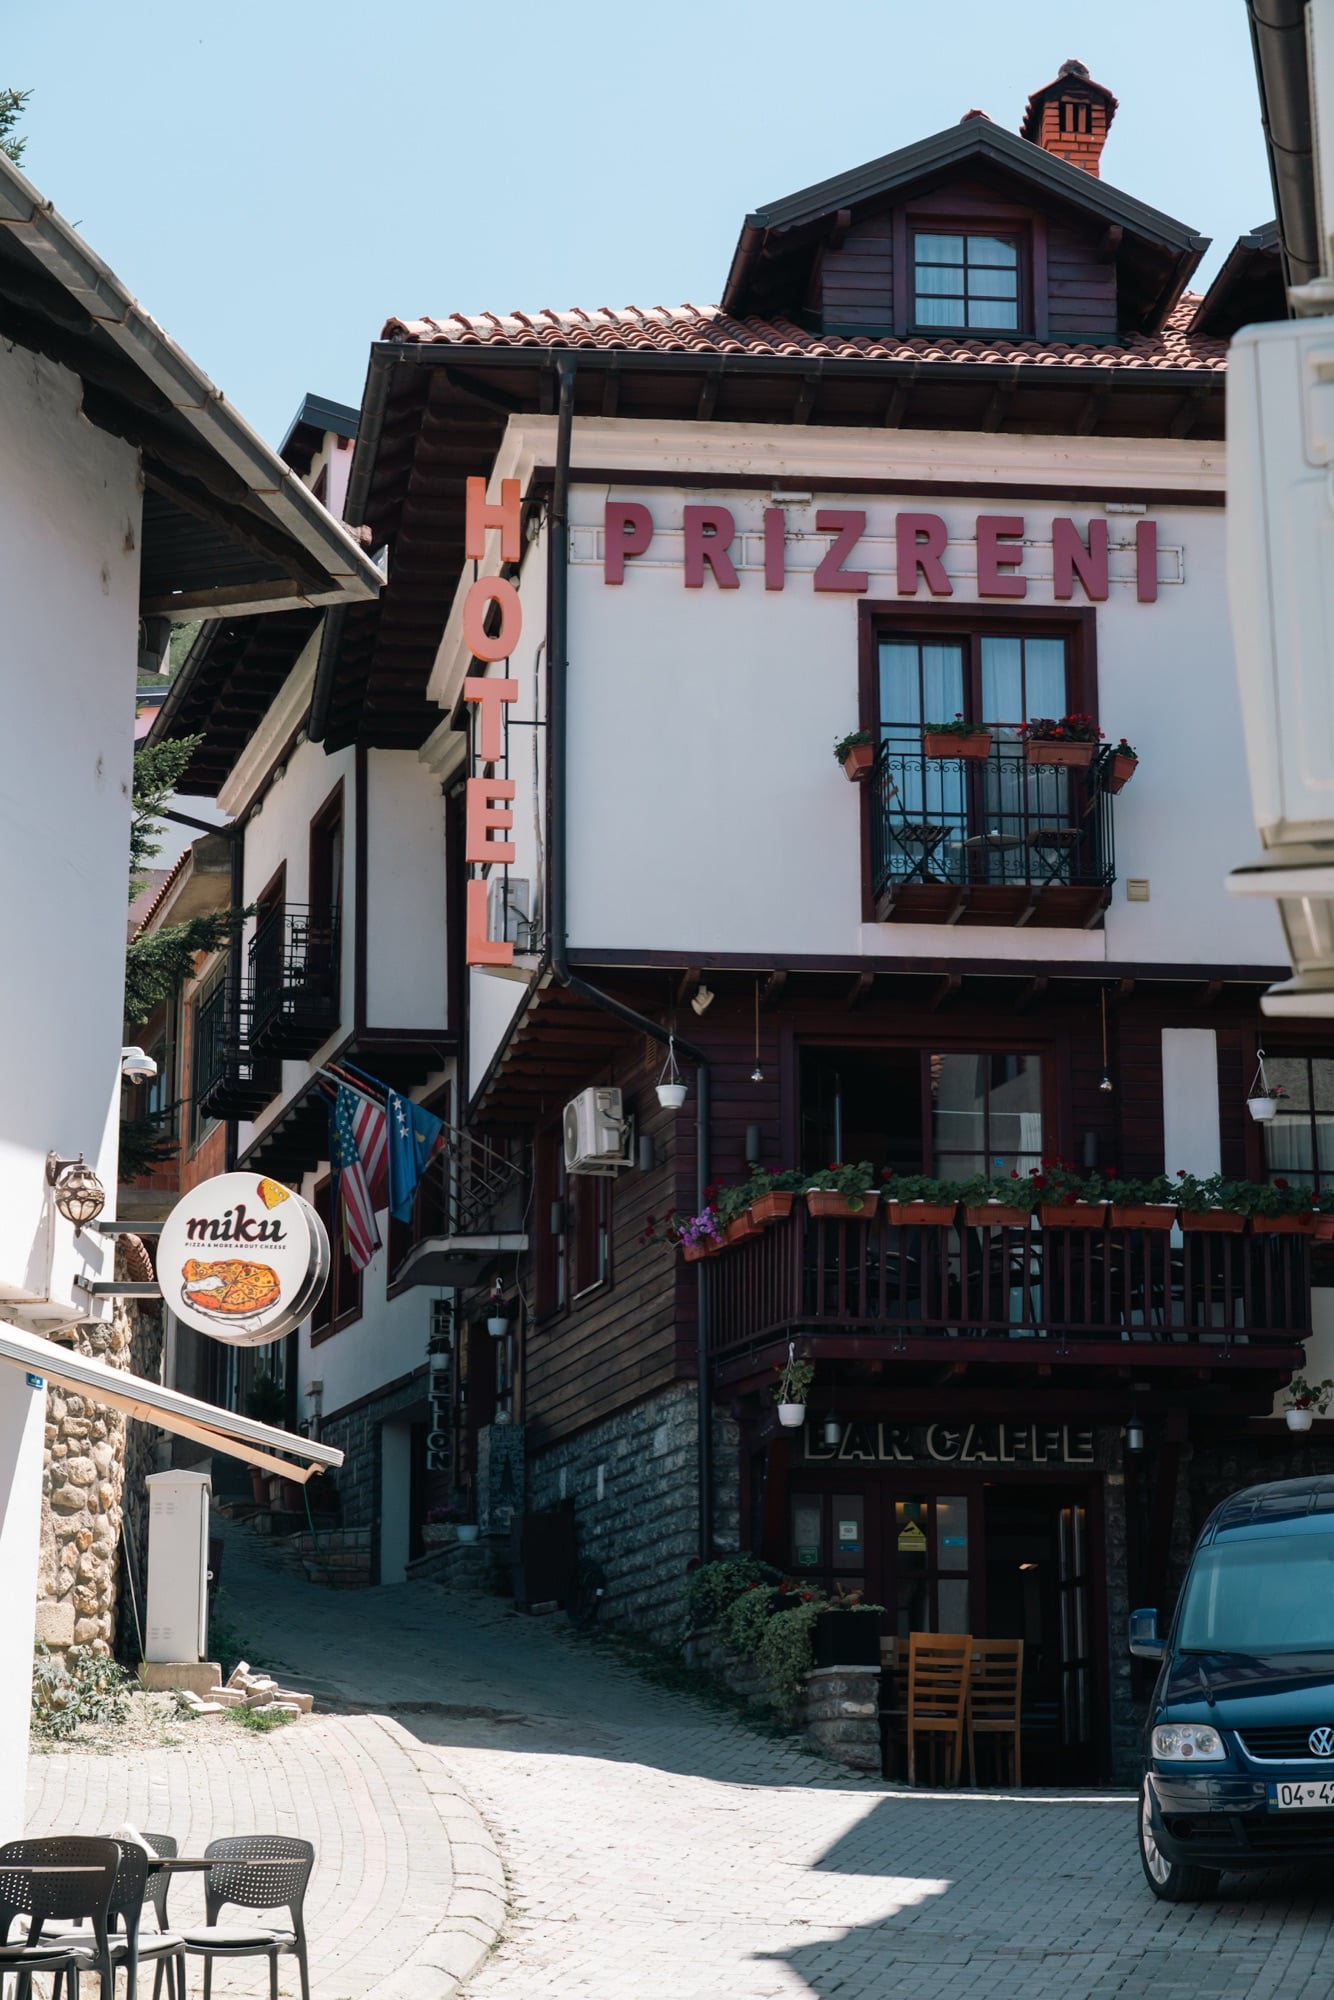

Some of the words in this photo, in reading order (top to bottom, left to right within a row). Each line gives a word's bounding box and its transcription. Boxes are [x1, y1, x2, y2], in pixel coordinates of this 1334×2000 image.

[604, 502, 1158, 602] PRIZRENI
[462, 475, 522, 967] HOTEL
[186, 1204, 287, 1242] miku
[426, 1299, 452, 1471] REPTION
[803, 1422, 914, 1460] BAR
[926, 1422, 1095, 1464] CAFFE
[1281, 1784, 1304, 1806] 04
